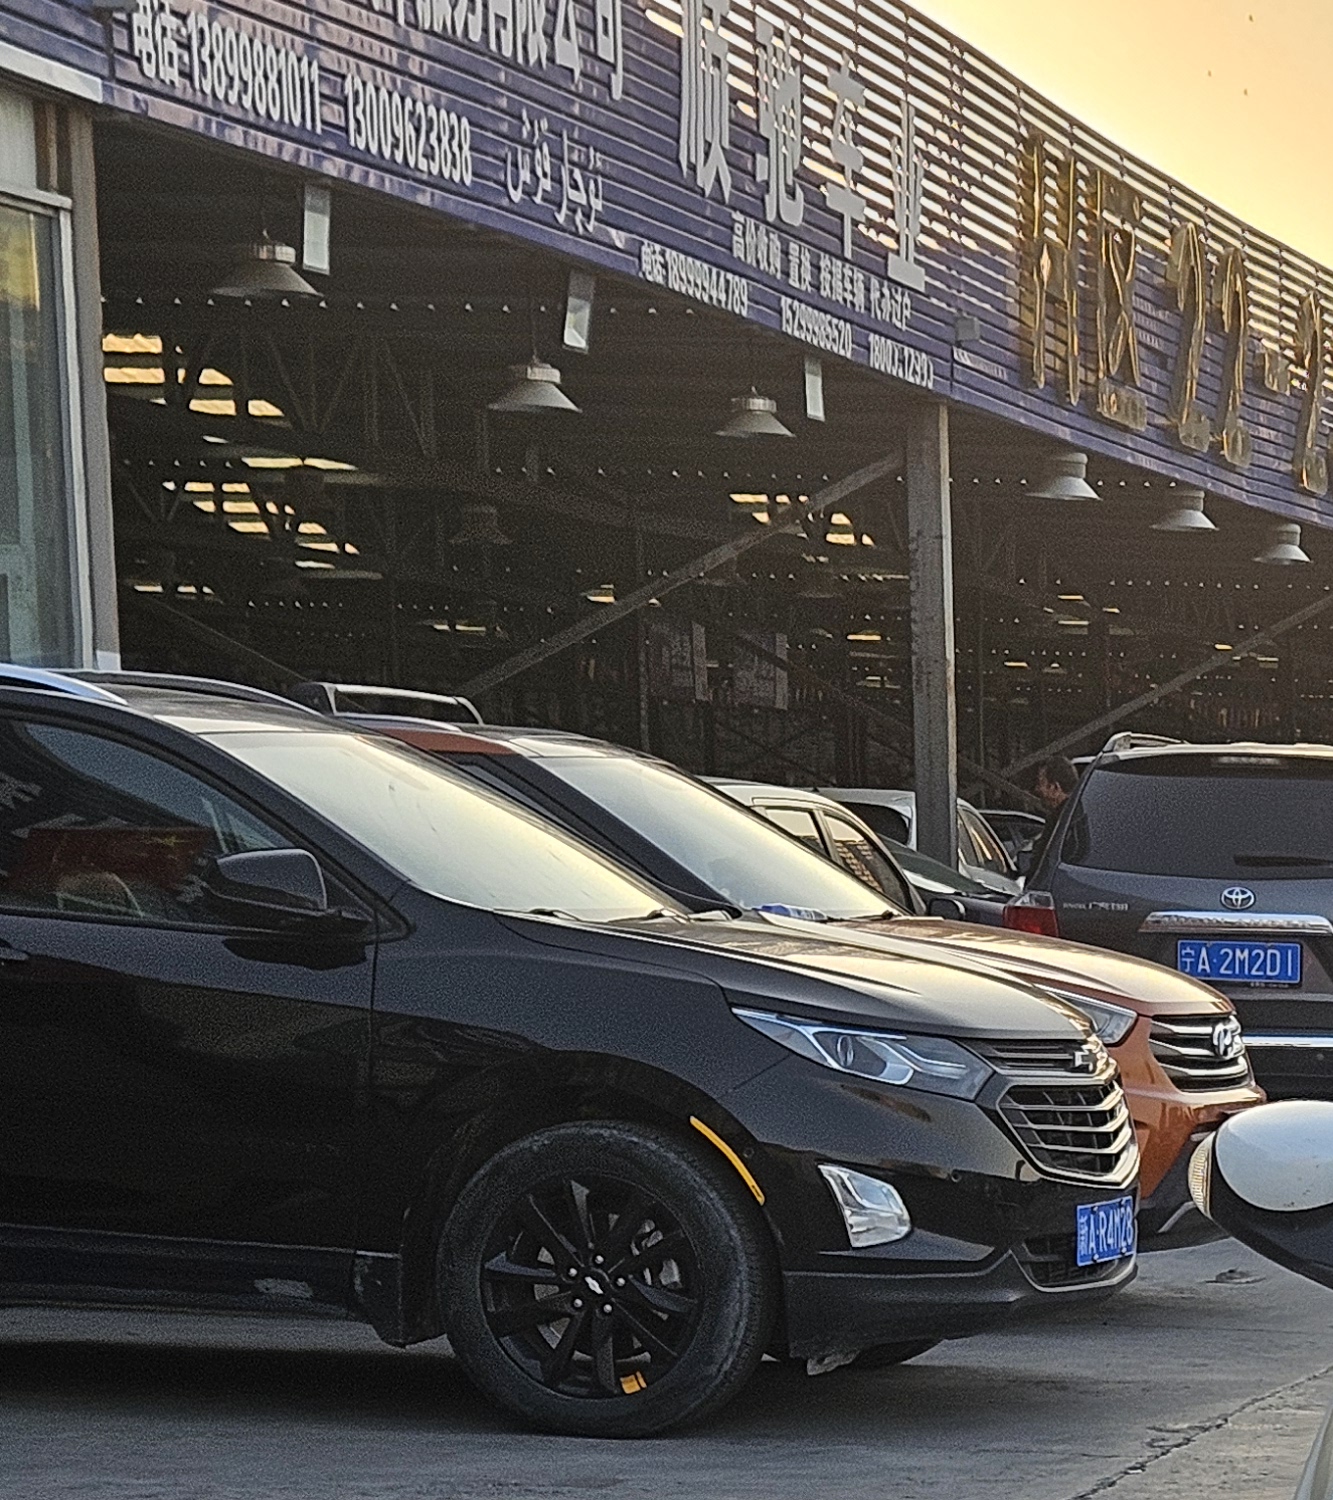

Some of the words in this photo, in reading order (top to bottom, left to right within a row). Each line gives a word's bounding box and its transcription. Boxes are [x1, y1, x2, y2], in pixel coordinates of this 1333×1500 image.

[344, 74, 472, 187] 13009623838
[731, 210, 782, 281] 高价收购
[788, 241, 812, 293] 置换
[819, 252, 866, 314] 按揭车辆
[870, 275, 912, 332] 代办过户
